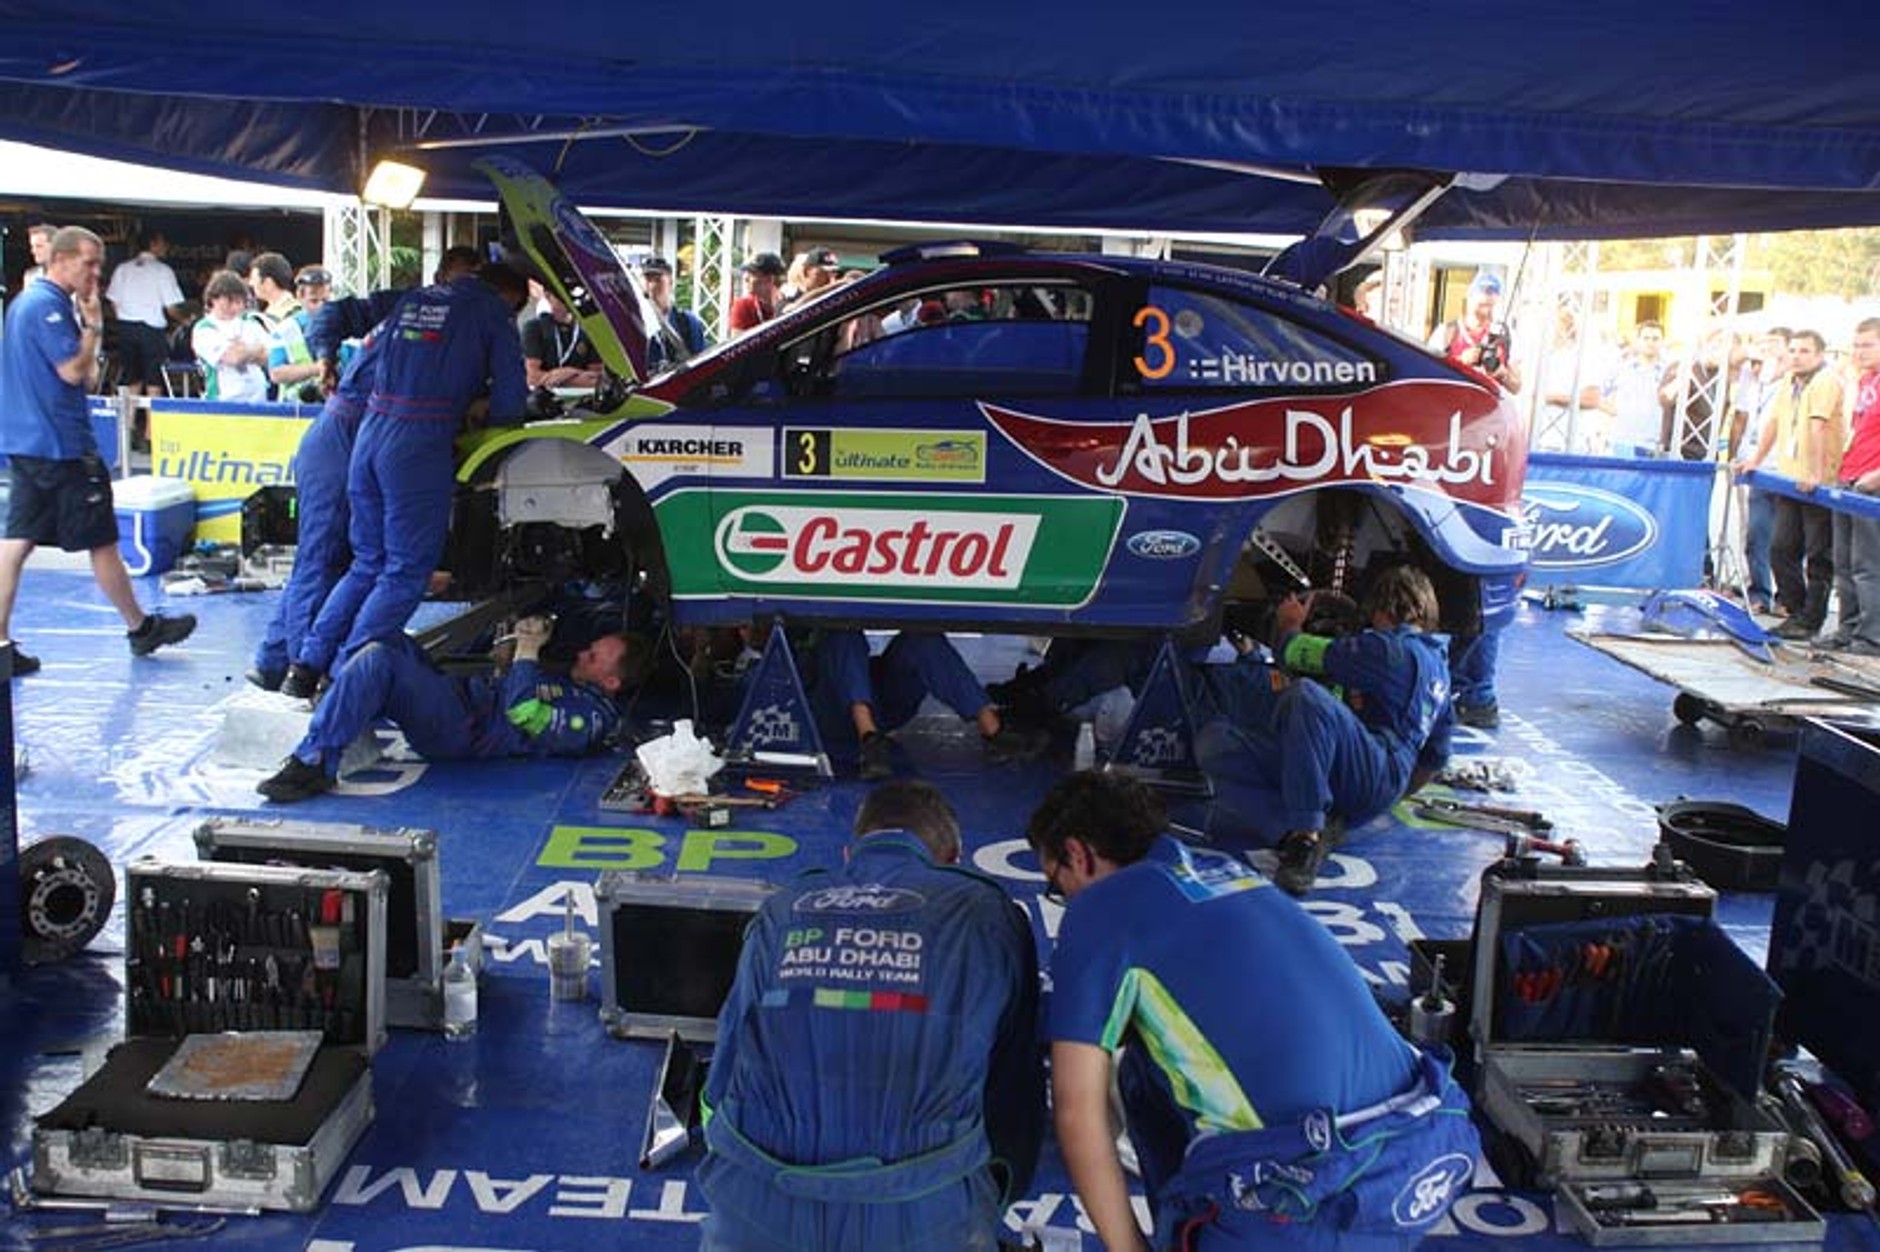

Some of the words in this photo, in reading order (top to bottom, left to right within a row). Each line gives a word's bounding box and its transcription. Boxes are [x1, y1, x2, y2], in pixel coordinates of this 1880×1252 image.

[1132, 305, 1176, 380] 3
[1223, 354, 1376, 382] Hirvonen
[637, 439, 743, 456] KÄRCHER
[799, 432, 817, 474] 3
[835, 451, 911, 468] ultimate
[793, 517, 1015, 577] Castrol
[536, 826, 798, 871] BP
[814, 885, 898, 910] Ford
[785, 927, 824, 948] BP
[835, 927, 923, 950] FORD
[782, 947, 832, 966] ABU
[838, 949, 921, 969] DHABI
[779, 967, 827, 978] WORLD
[829, 968, 874, 980] RALLY
[878, 971, 920, 983] TEAM
[332, 1165, 711, 1223] TEAM
